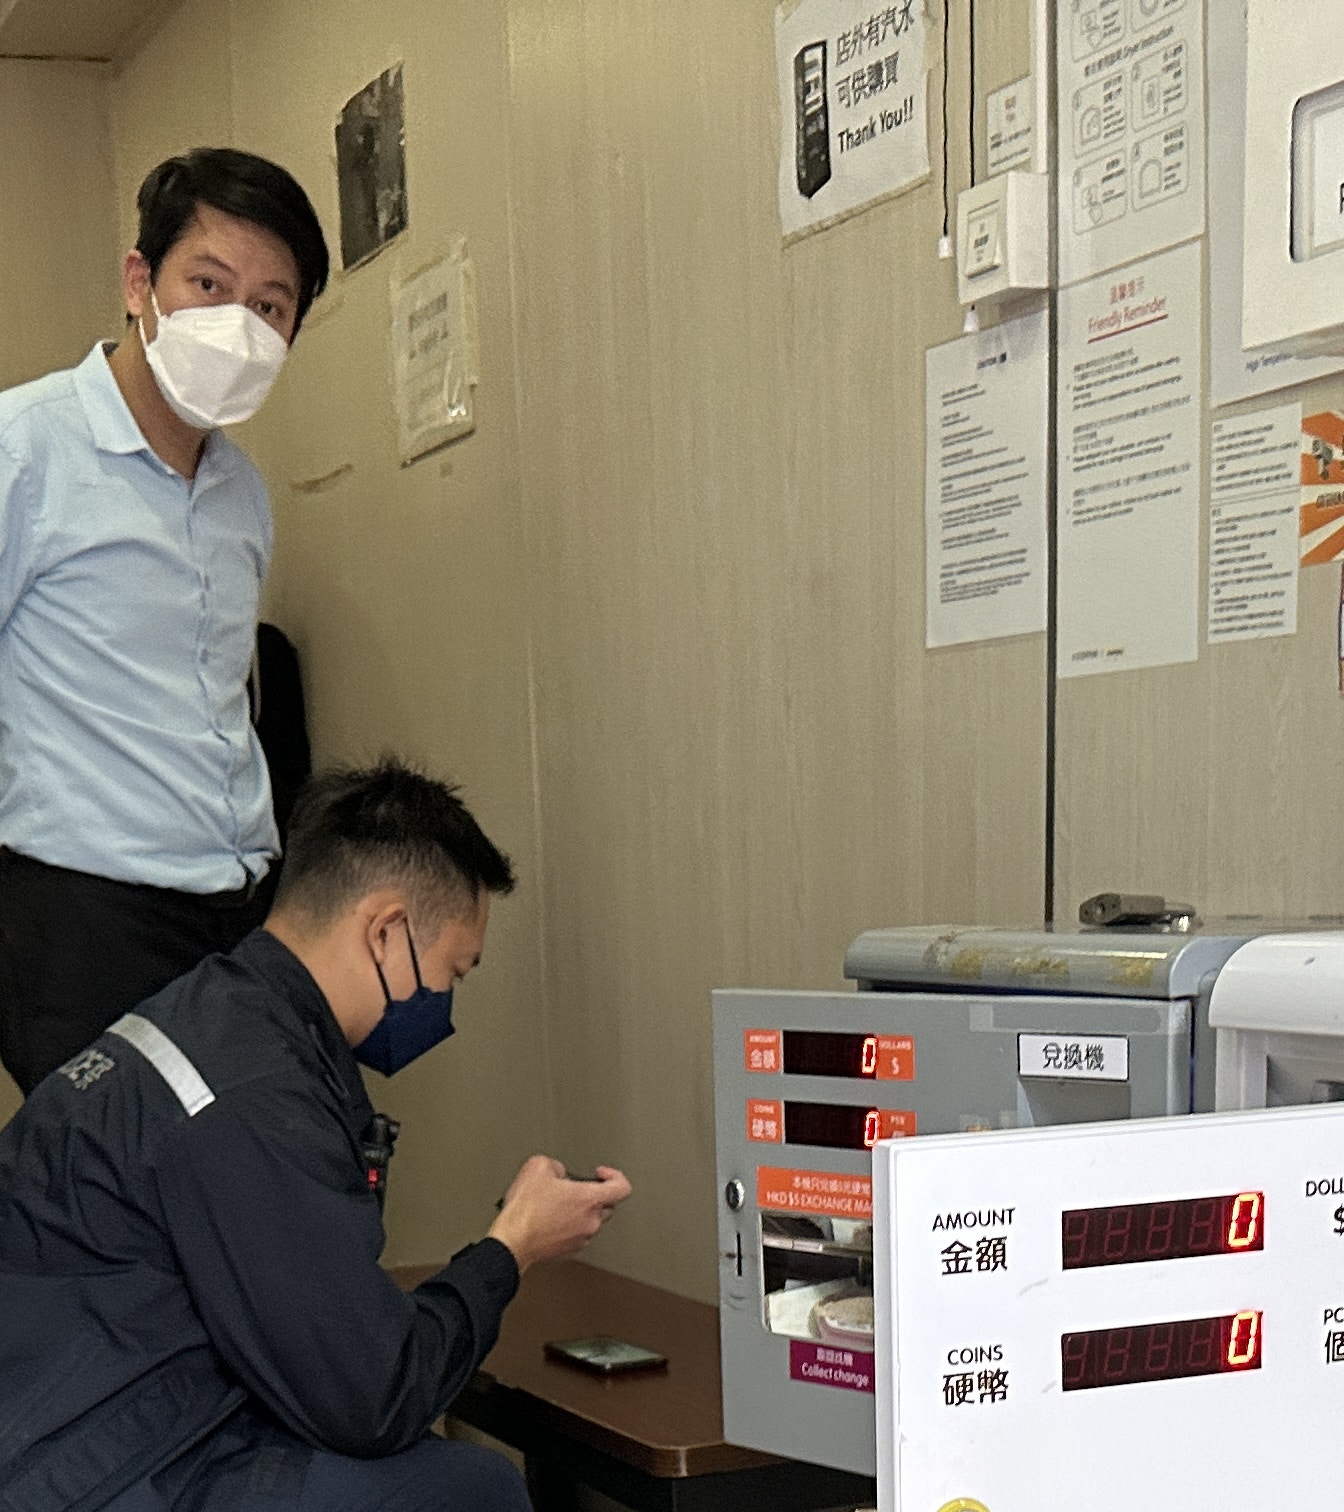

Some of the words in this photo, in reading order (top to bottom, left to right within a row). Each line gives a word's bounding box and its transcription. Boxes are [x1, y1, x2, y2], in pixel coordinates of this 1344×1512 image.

[835, 50, 899, 108] 可供購買
[838, 115, 876, 153] Thank
[879, 95, 914, 134] You!!
[862, 1037, 877, 1074] 0
[864, 1111, 880, 1147] 0
[801, 1193, 852, 1213] EXCHANGE
[932, 1207, 1016, 1232] AMOUNT
[1228, 1191, 1260, 1248] 0
[940, 1236, 1008, 1276] 金額
[947, 1344, 1004, 1366] COINS
[1228, 1311, 1259, 1366] 0
[802, 1361, 833, 1380] Collect
[834, 1369, 869, 1388] change
[942, 1367, 1009, 1407] 硬幣
